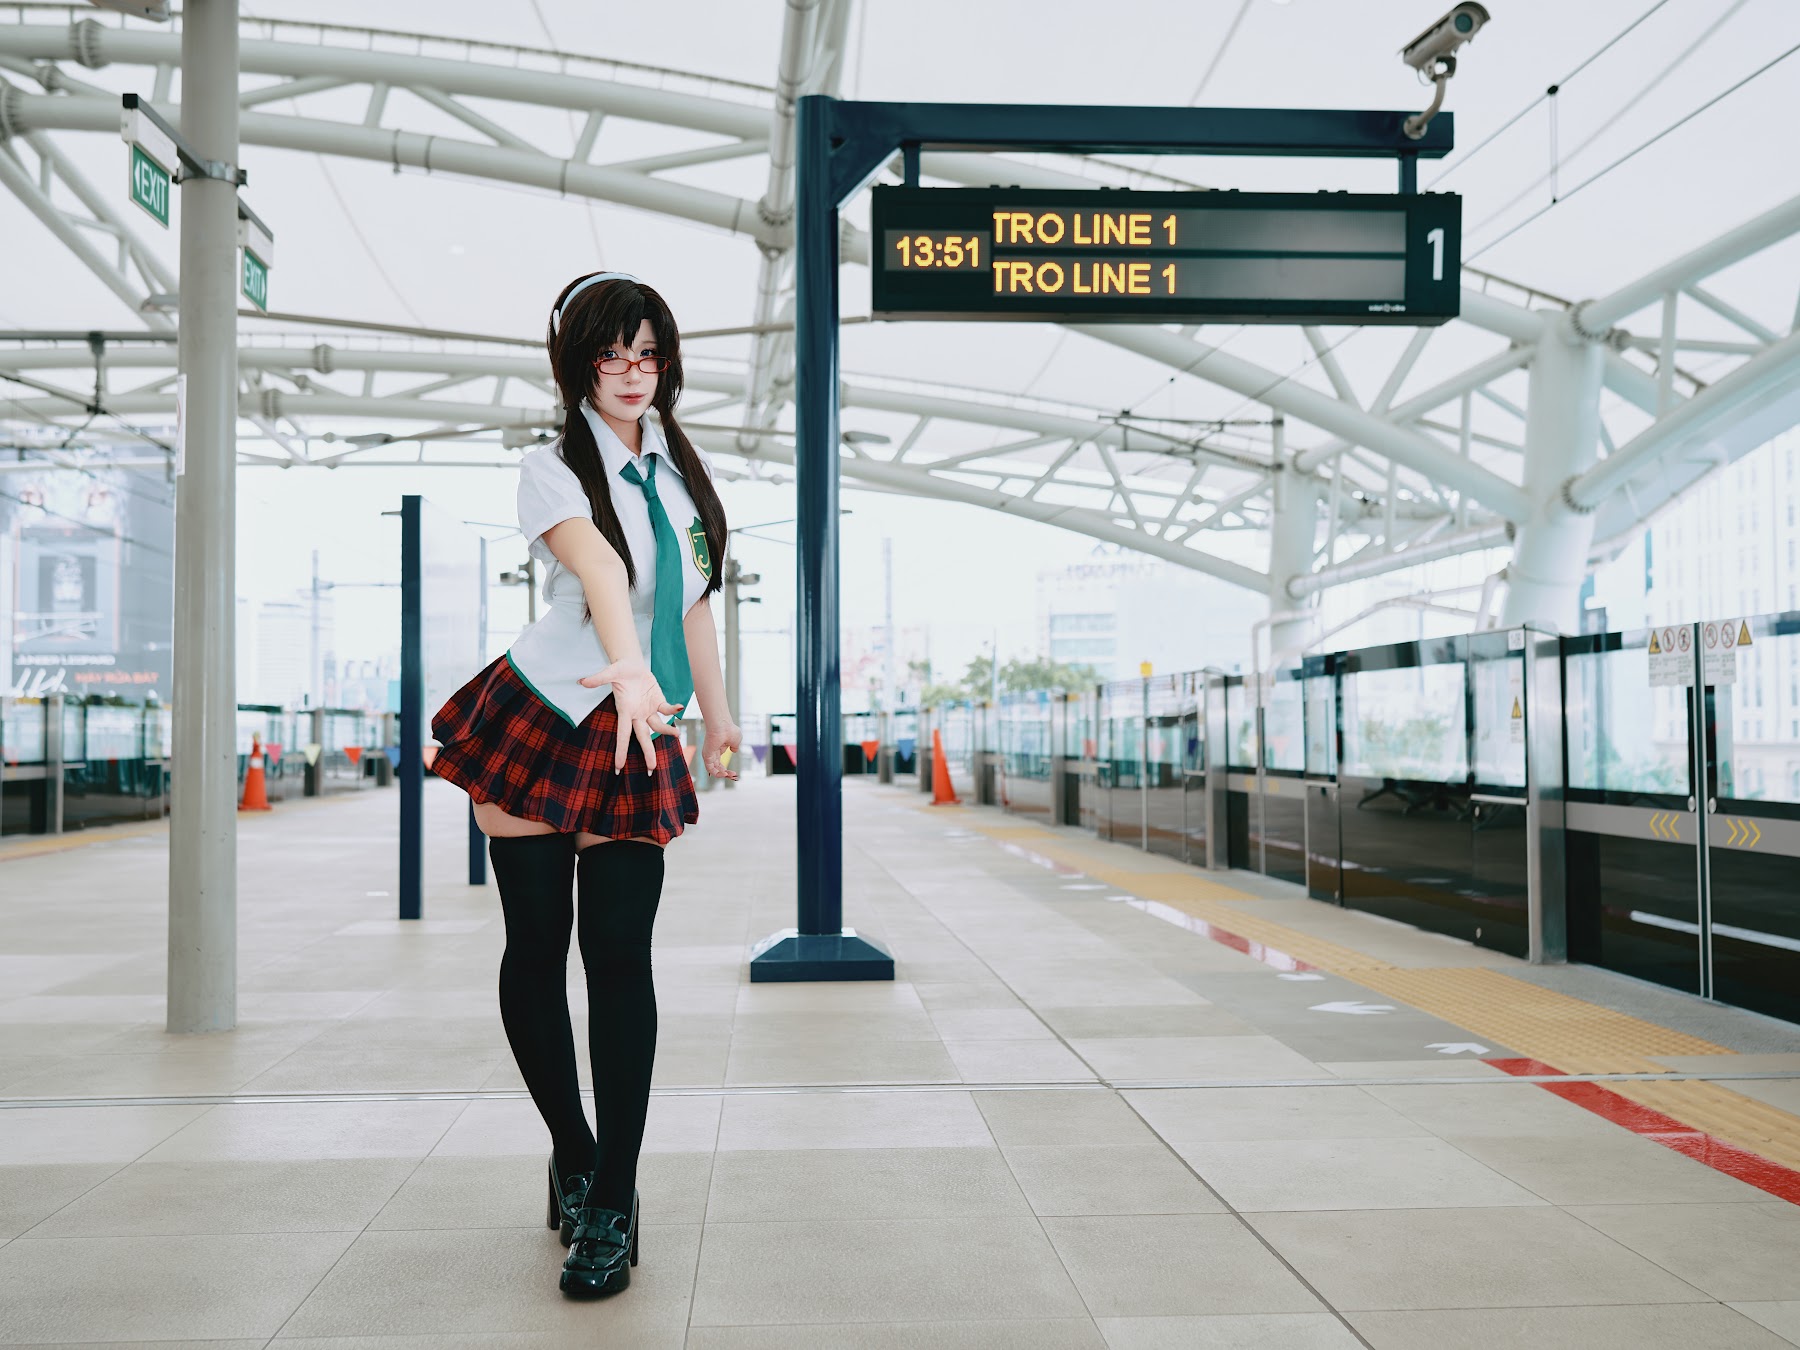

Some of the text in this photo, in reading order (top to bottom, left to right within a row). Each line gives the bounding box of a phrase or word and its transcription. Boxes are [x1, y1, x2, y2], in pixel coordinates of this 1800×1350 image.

[141, 163, 167, 216] EXIT
[992, 212, 1177, 246] TRO LINE 1
[896, 235, 979, 267] 13:51
[1427, 228, 1444, 281] 1
[244, 258, 262, 301] EXIT
[992, 261, 1176, 295] TRO LINE 1
